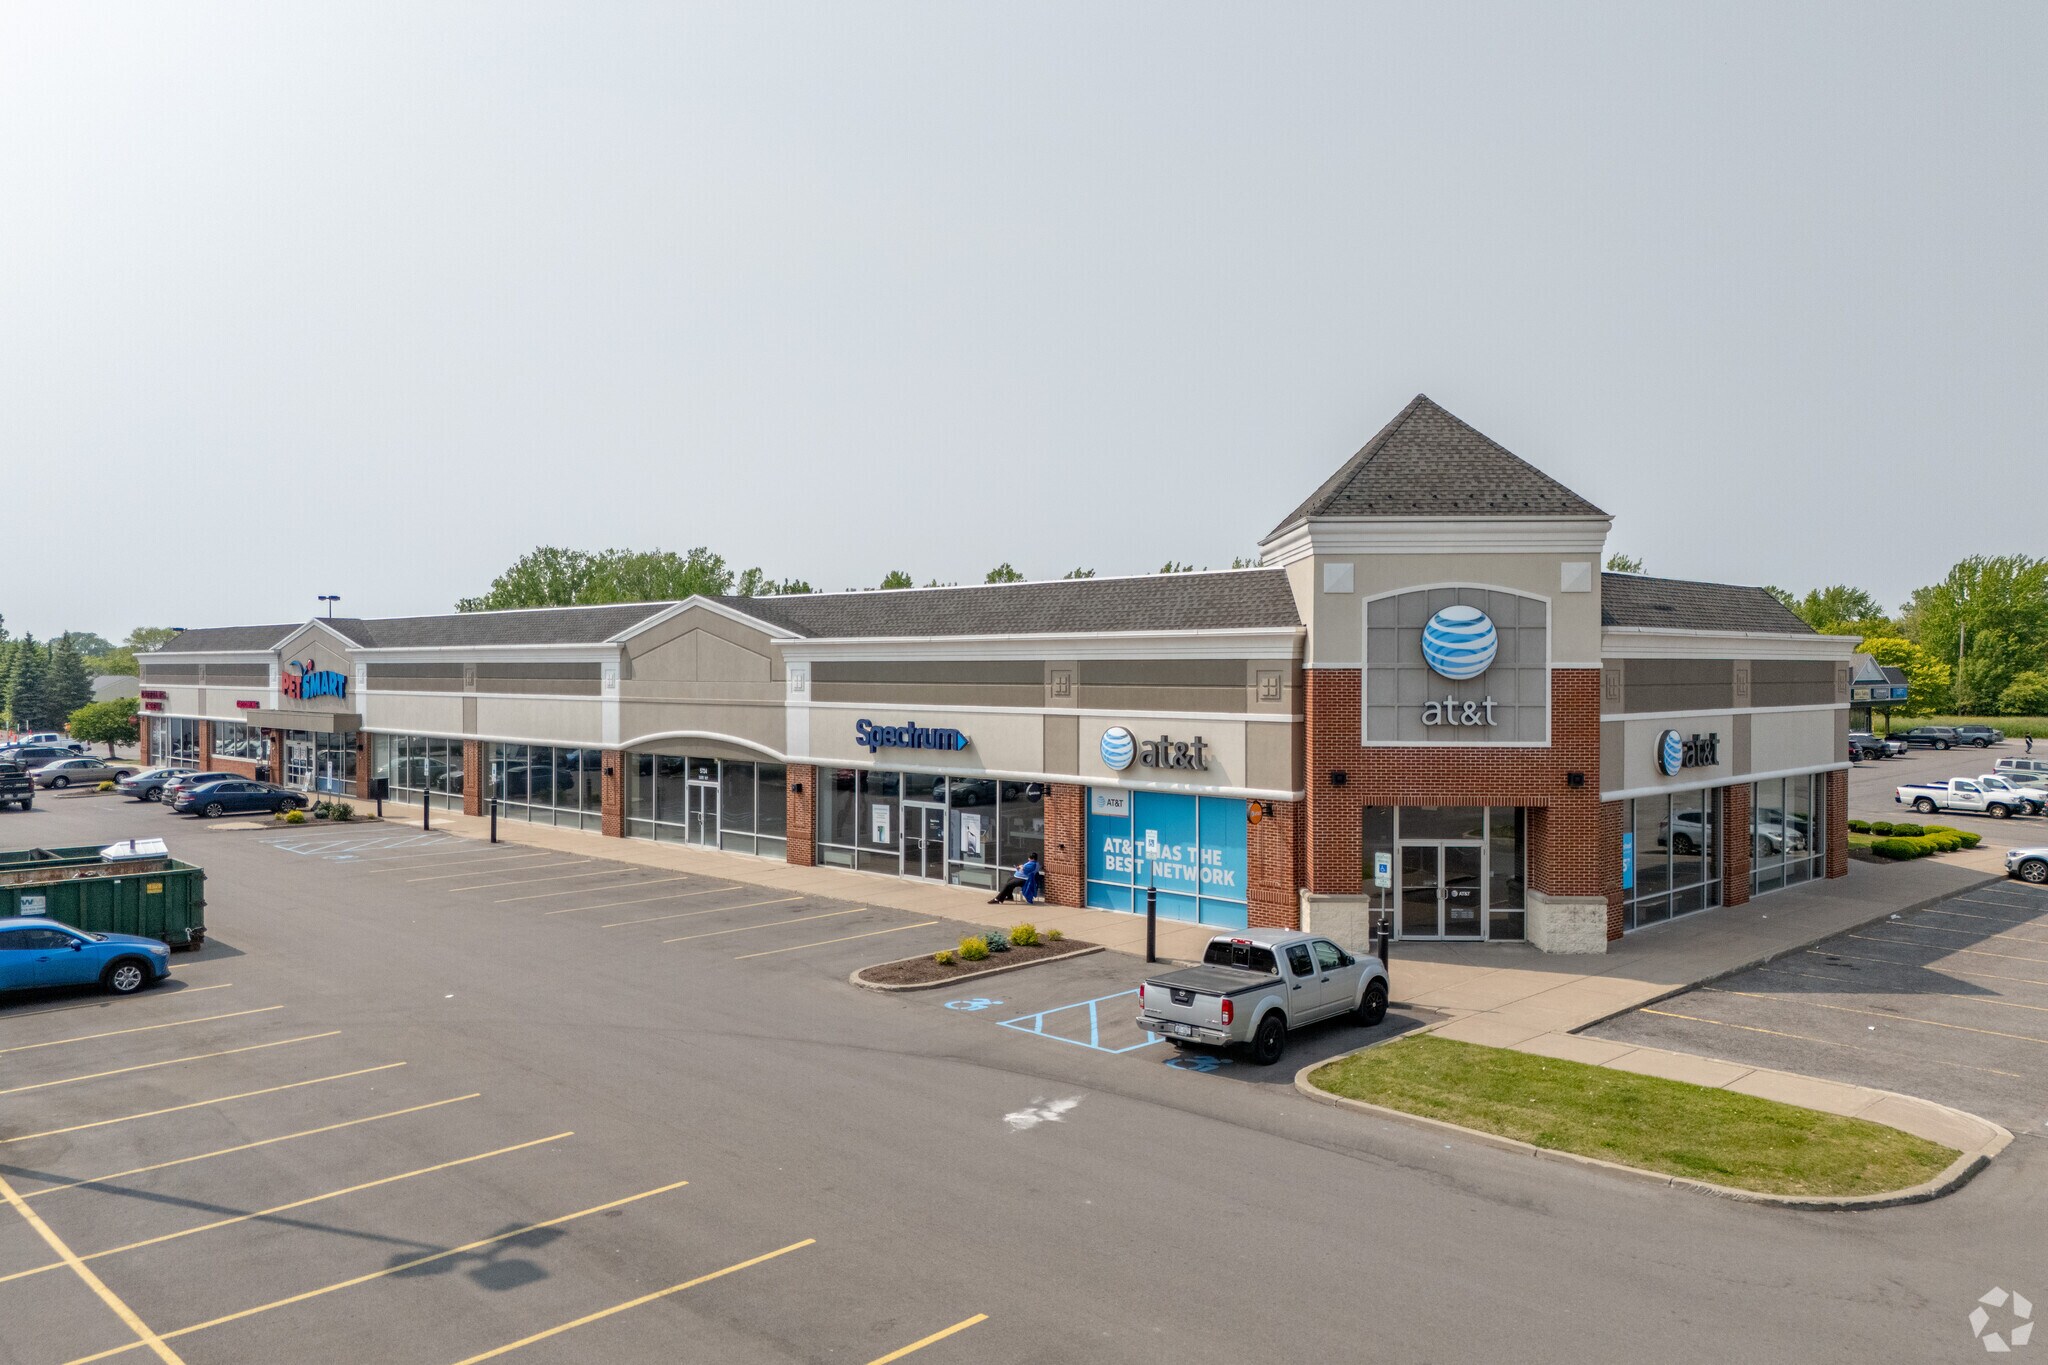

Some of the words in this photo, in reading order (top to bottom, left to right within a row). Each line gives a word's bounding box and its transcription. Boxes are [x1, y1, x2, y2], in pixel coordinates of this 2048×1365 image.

[281, 670, 347, 699] PETSMART
[1421, 694, 1498, 726] at&t
[856, 718, 960, 753] Spectrum
[1682, 732, 1720, 768] at&t
[1140, 734, 1208, 771] at&t
[1106, 798, 1124, 807] AT&T
[1105, 854, 1145, 875] BEST
[1152, 860, 1236, 888] NETWORK
[1187, 846, 1223, 867] THE
